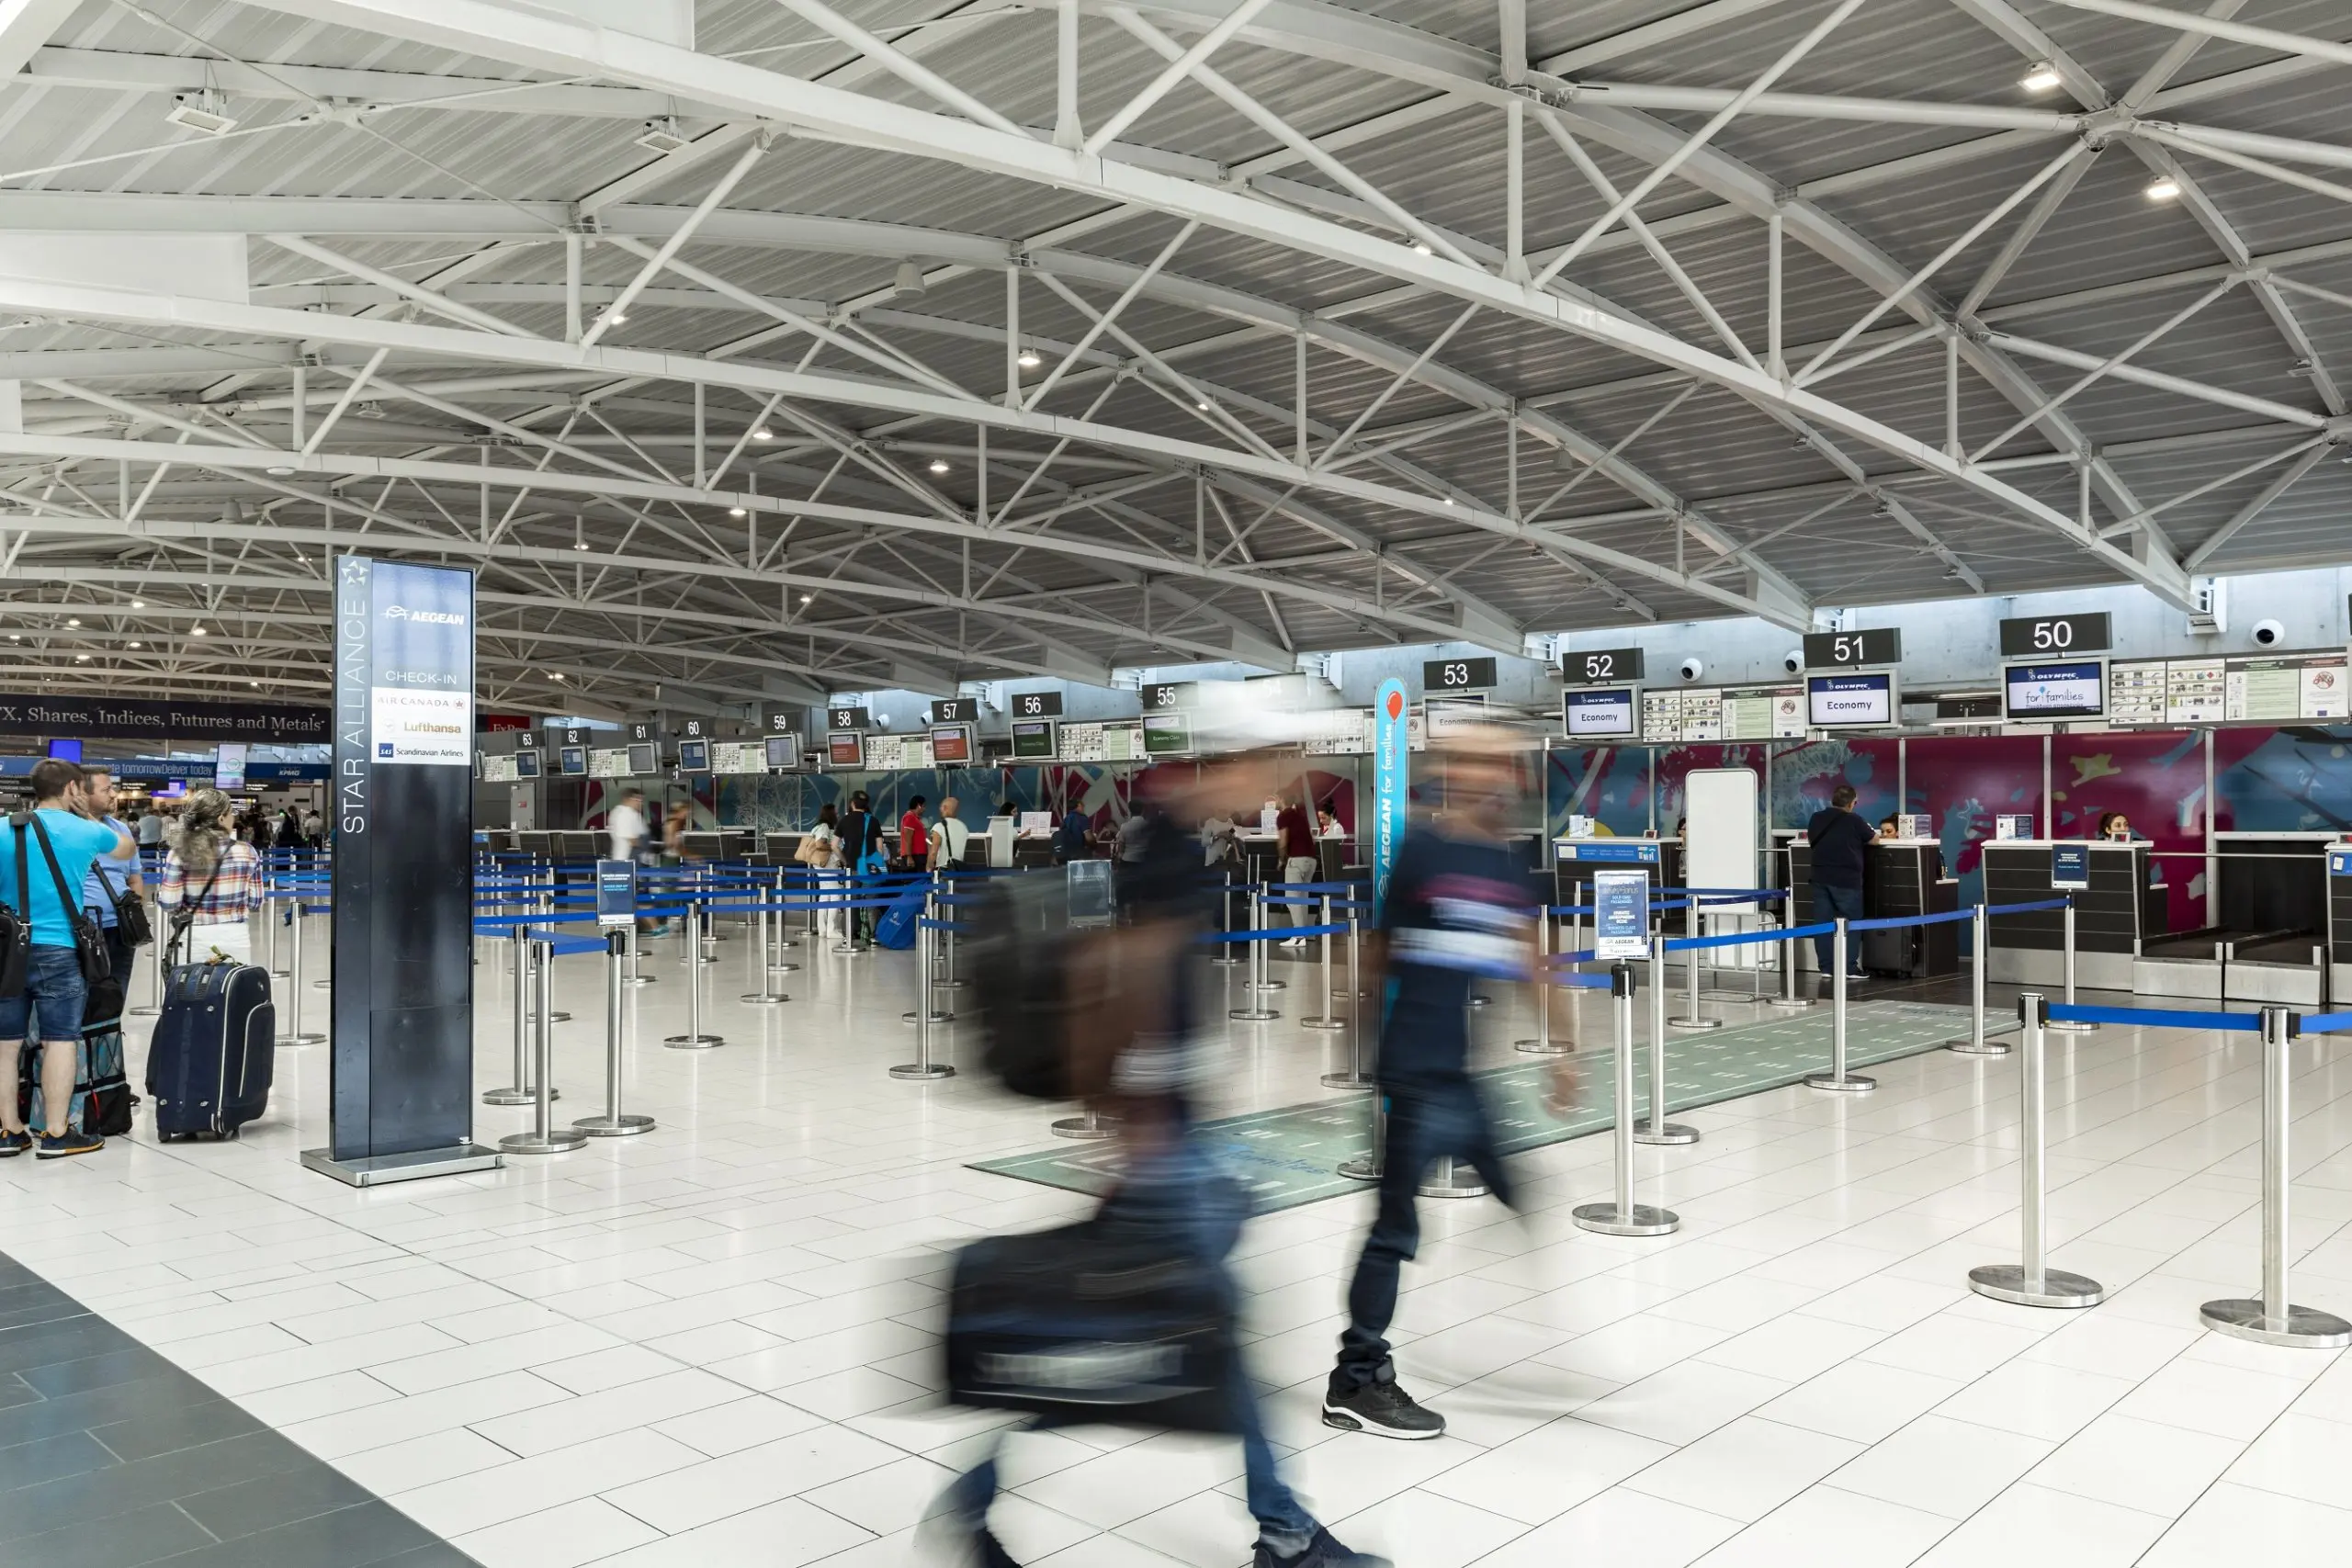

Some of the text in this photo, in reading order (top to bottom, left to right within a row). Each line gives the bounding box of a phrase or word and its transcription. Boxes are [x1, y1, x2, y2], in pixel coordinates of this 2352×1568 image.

[411, 611, 465, 626] AEGEAN
[2033, 621, 2073, 649] 50
[1834, 636, 1864, 661] 51
[1444, 663, 1469, 685] 53
[1586, 655, 1614, 678] 52
[385, 671, 458, 684] CHECK-IN
[378, 696, 450, 707] AIR CANADA
[1158, 687, 1176, 705] 55
[2026, 688, 2084, 704] for families
[944, 703, 957, 719] 57
[1025, 696, 1041, 714] 56
[1826, 701, 1871, 711] Economy
[0, 705, 322, 731] X, Shares, Indices, Futures and Metals
[343, 600, 366, 834] STAR ALLIANCE
[774, 715, 786, 730] 59
[838, 711, 852, 727] 58
[1581, 714, 1618, 722] Economy
[404, 721, 462, 734] Lufthansa
[636, 725, 646, 739] 61
[688, 721, 699, 735] 60
[523, 733, 533, 746] 63
[568, 730, 578, 743] 62
[396, 748, 438, 757] Scandinavian
[441, 749, 464, 757] Airlines
[1379, 723, 1392, 869] AEGEAN for families
